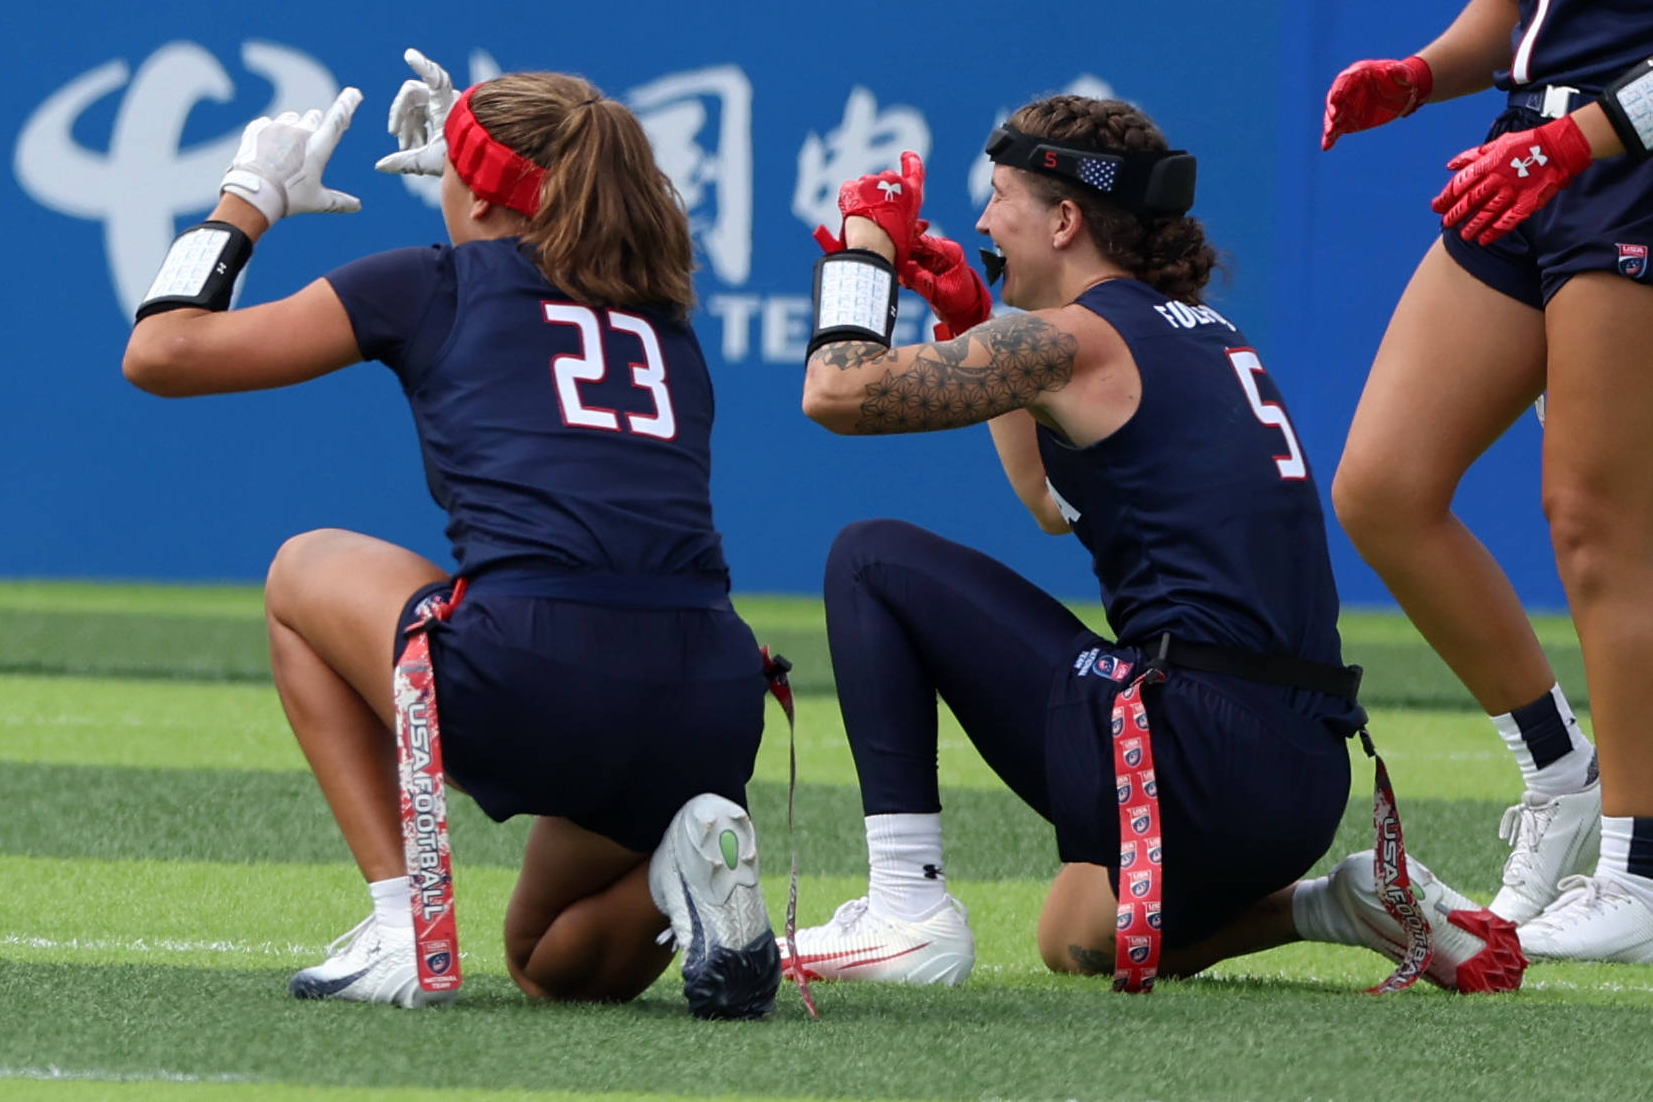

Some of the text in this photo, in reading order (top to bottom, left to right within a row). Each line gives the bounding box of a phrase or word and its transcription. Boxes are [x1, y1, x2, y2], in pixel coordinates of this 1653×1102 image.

[540, 300, 679, 442] 23
[1224, 347, 1308, 481] 5
[407, 702, 432, 772] USA
[412, 775, 444, 921] FOOTBALL
[1383, 817, 1400, 886] USA
